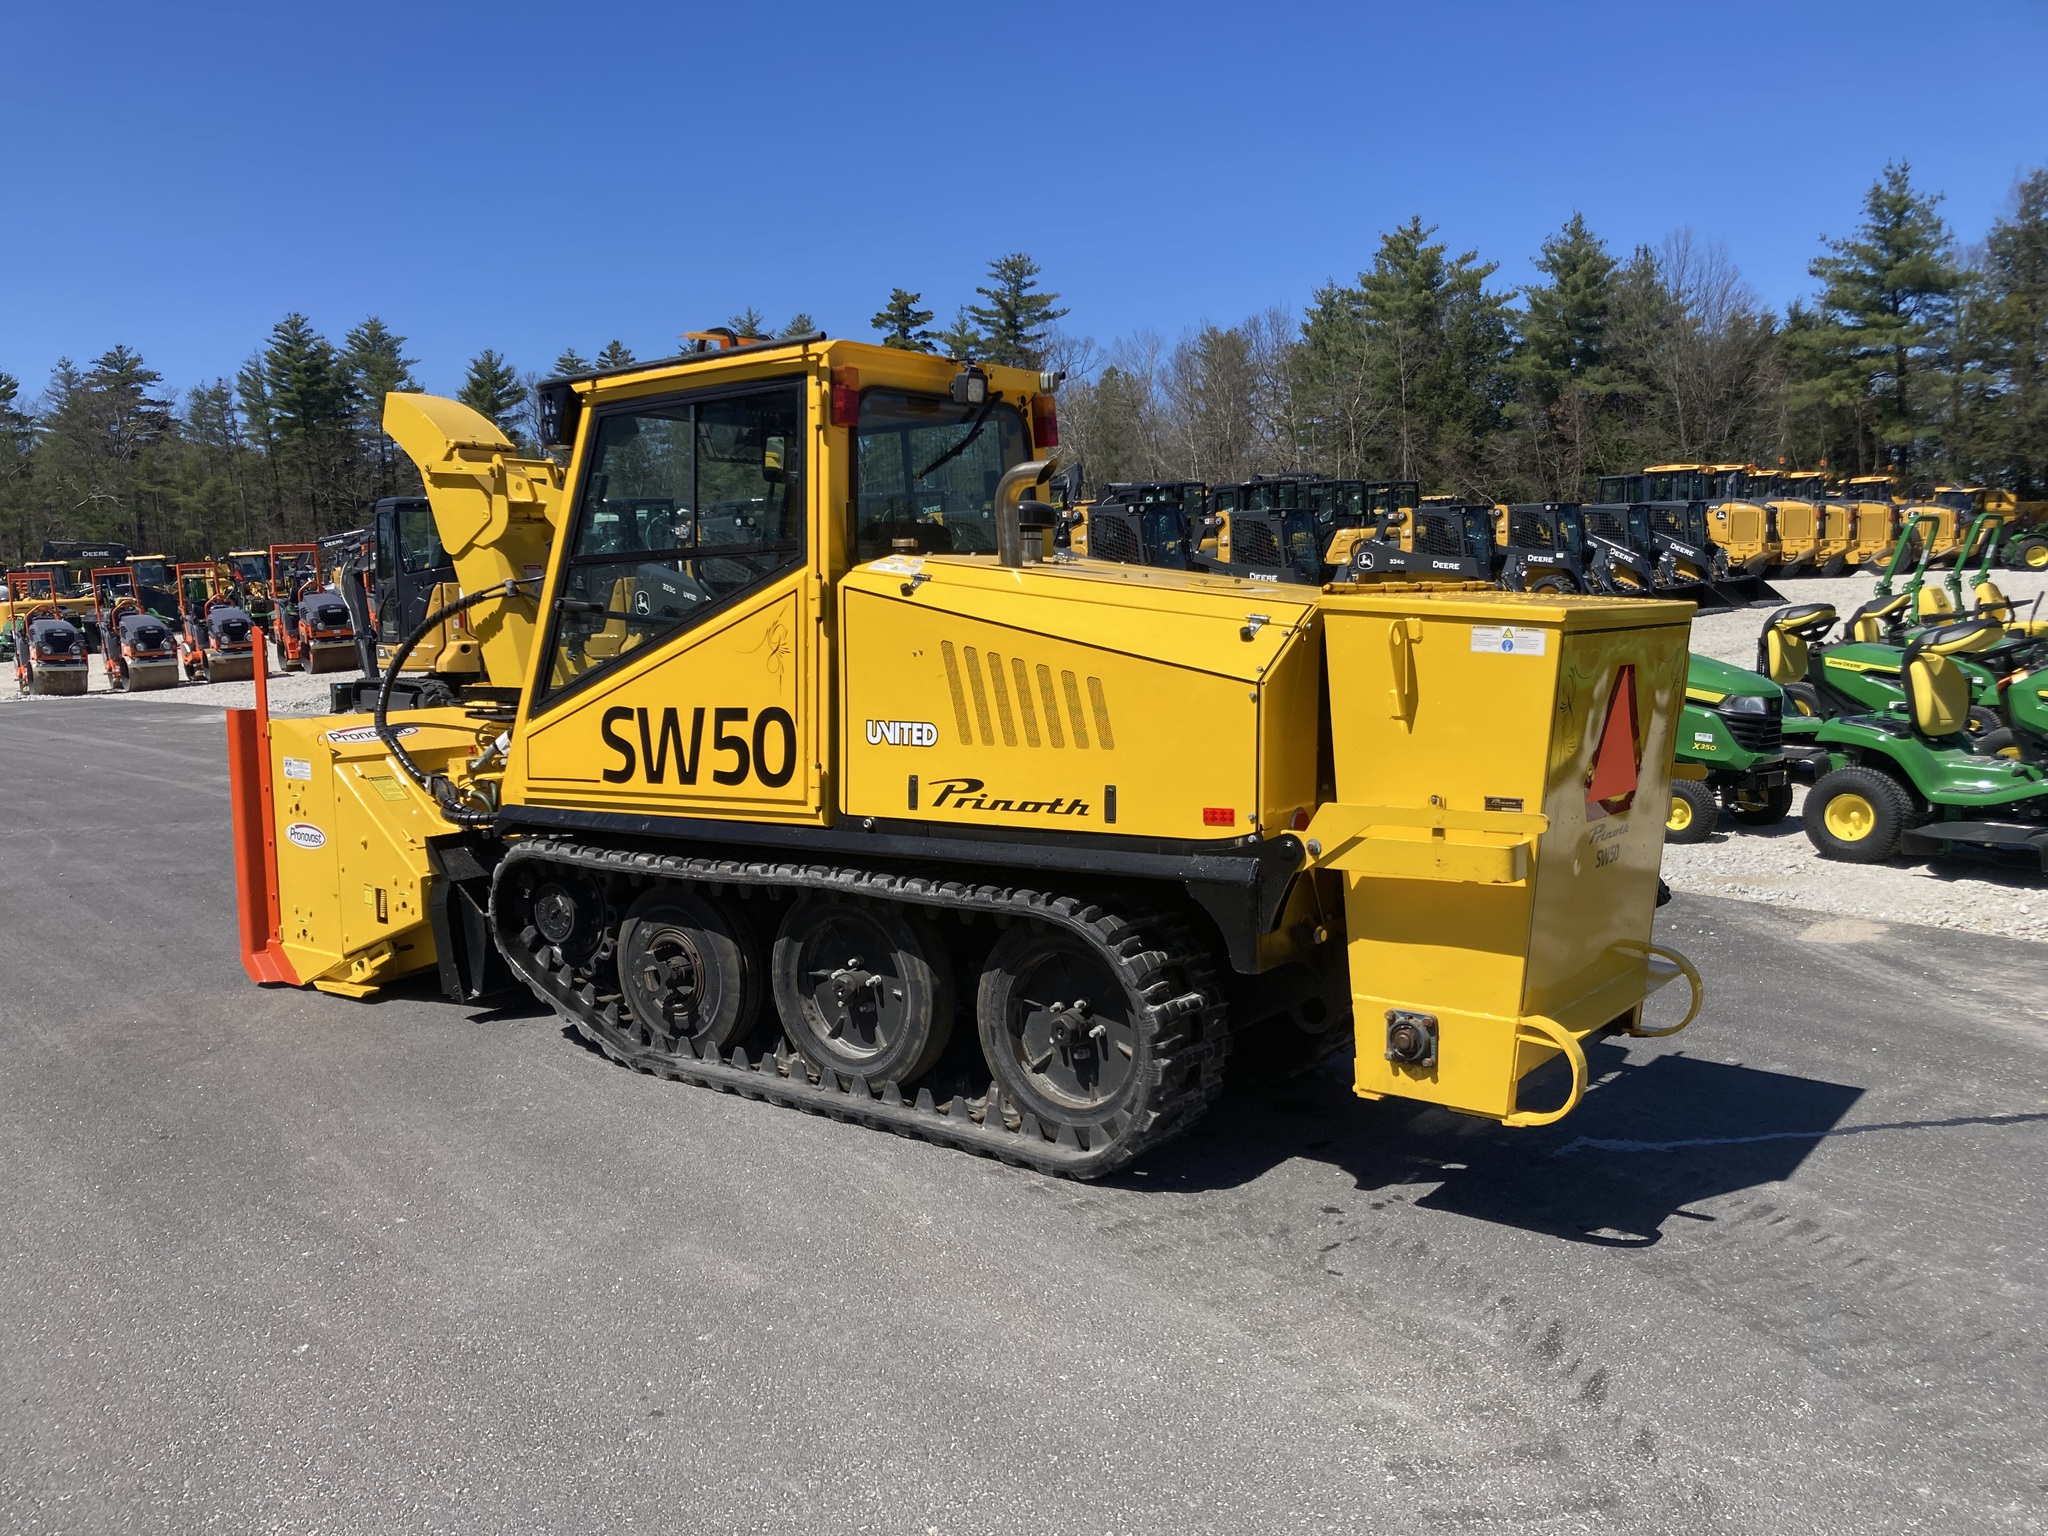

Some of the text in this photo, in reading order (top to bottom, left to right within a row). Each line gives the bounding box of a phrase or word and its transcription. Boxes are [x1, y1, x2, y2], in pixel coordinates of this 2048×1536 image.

[1610, 548, 1634, 563] DEERE
[1670, 542, 1695, 557] DEERE
[1432, 560, 1460, 570] DEERE
[1527, 554, 1554, 563] DEERE
[1249, 572, 1278, 582] DEERE
[866, 719, 938, 747] UNITED
[601, 706, 796, 788] SW50
[1692, 742, 1717, 751] X350
[928, 778, 1090, 816] Prinoth
[290, 827, 322, 844] Pronovost
[1589, 823, 1629, 845] Prinoth
[1596, 843, 1619, 868] SW50
